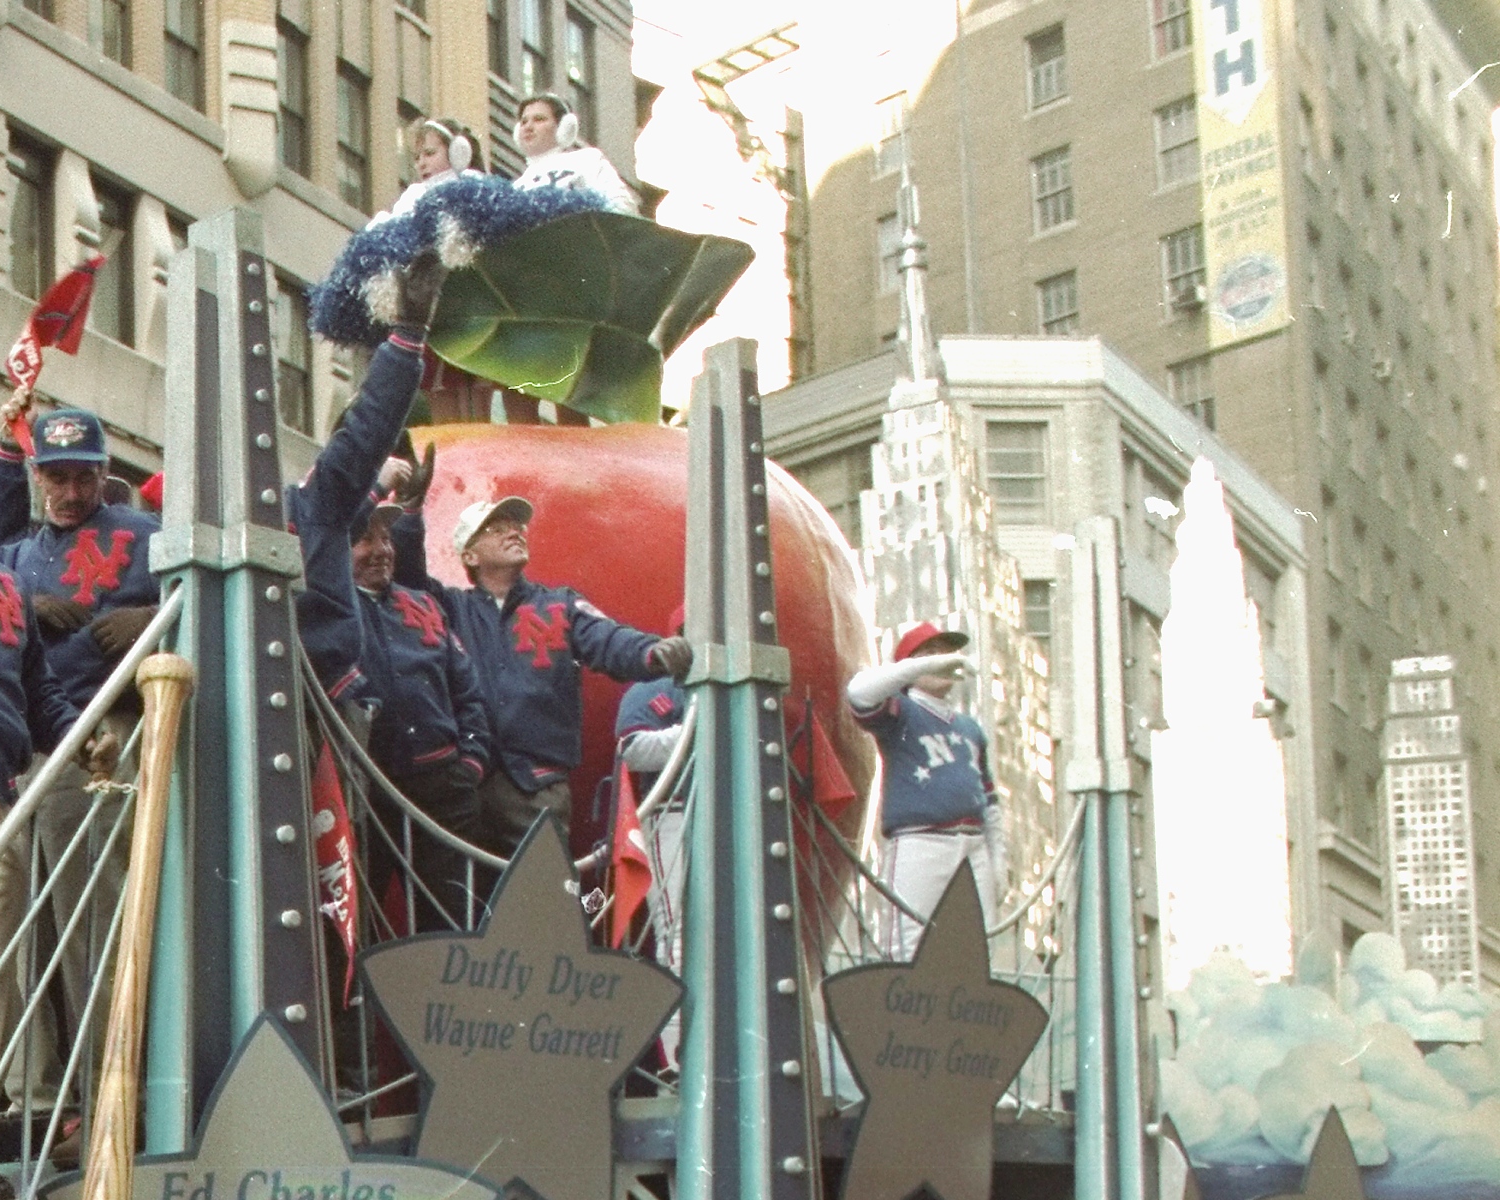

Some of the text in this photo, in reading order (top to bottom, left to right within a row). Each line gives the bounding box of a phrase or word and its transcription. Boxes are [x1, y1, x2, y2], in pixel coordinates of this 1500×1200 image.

[440, 943, 622, 1007] Duffy Dyer
[885, 975, 937, 1025] Gary
[423, 1001, 625, 1060] Wayne Garrett
[875, 1029, 938, 1080] Jerry
